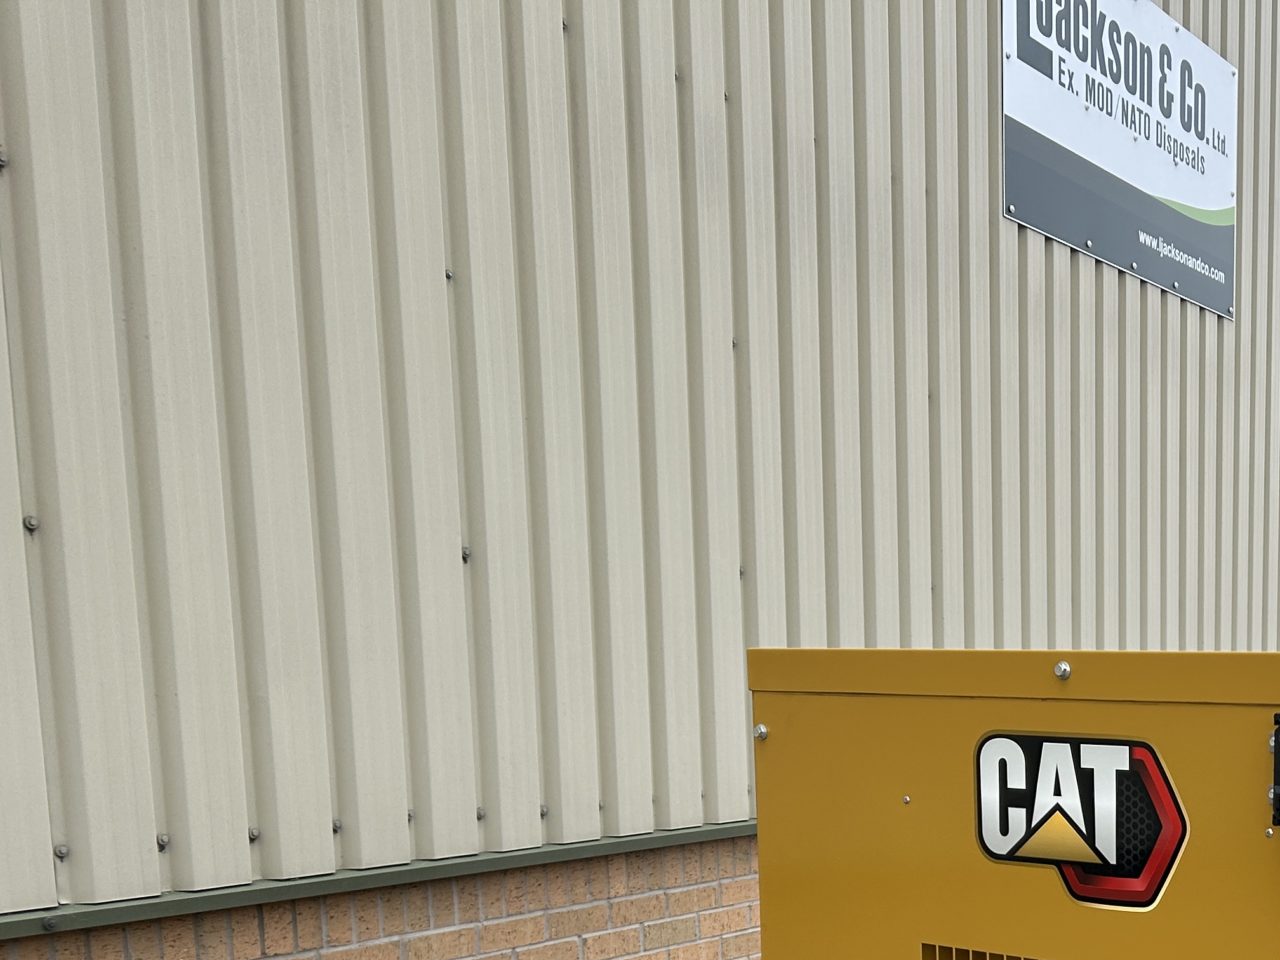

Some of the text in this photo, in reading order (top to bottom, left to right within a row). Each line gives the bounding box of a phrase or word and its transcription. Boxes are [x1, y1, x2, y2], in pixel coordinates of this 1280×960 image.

[1058, 55, 1078, 96] Ex.
[1156, 119, 1205, 175] Disposals
[1159, 43, 1174, 119] &
[1180, 59, 1209, 145] Co.
[1212, 128, 1228, 158] Ltd.
[979, 737, 1130, 865] CAT
